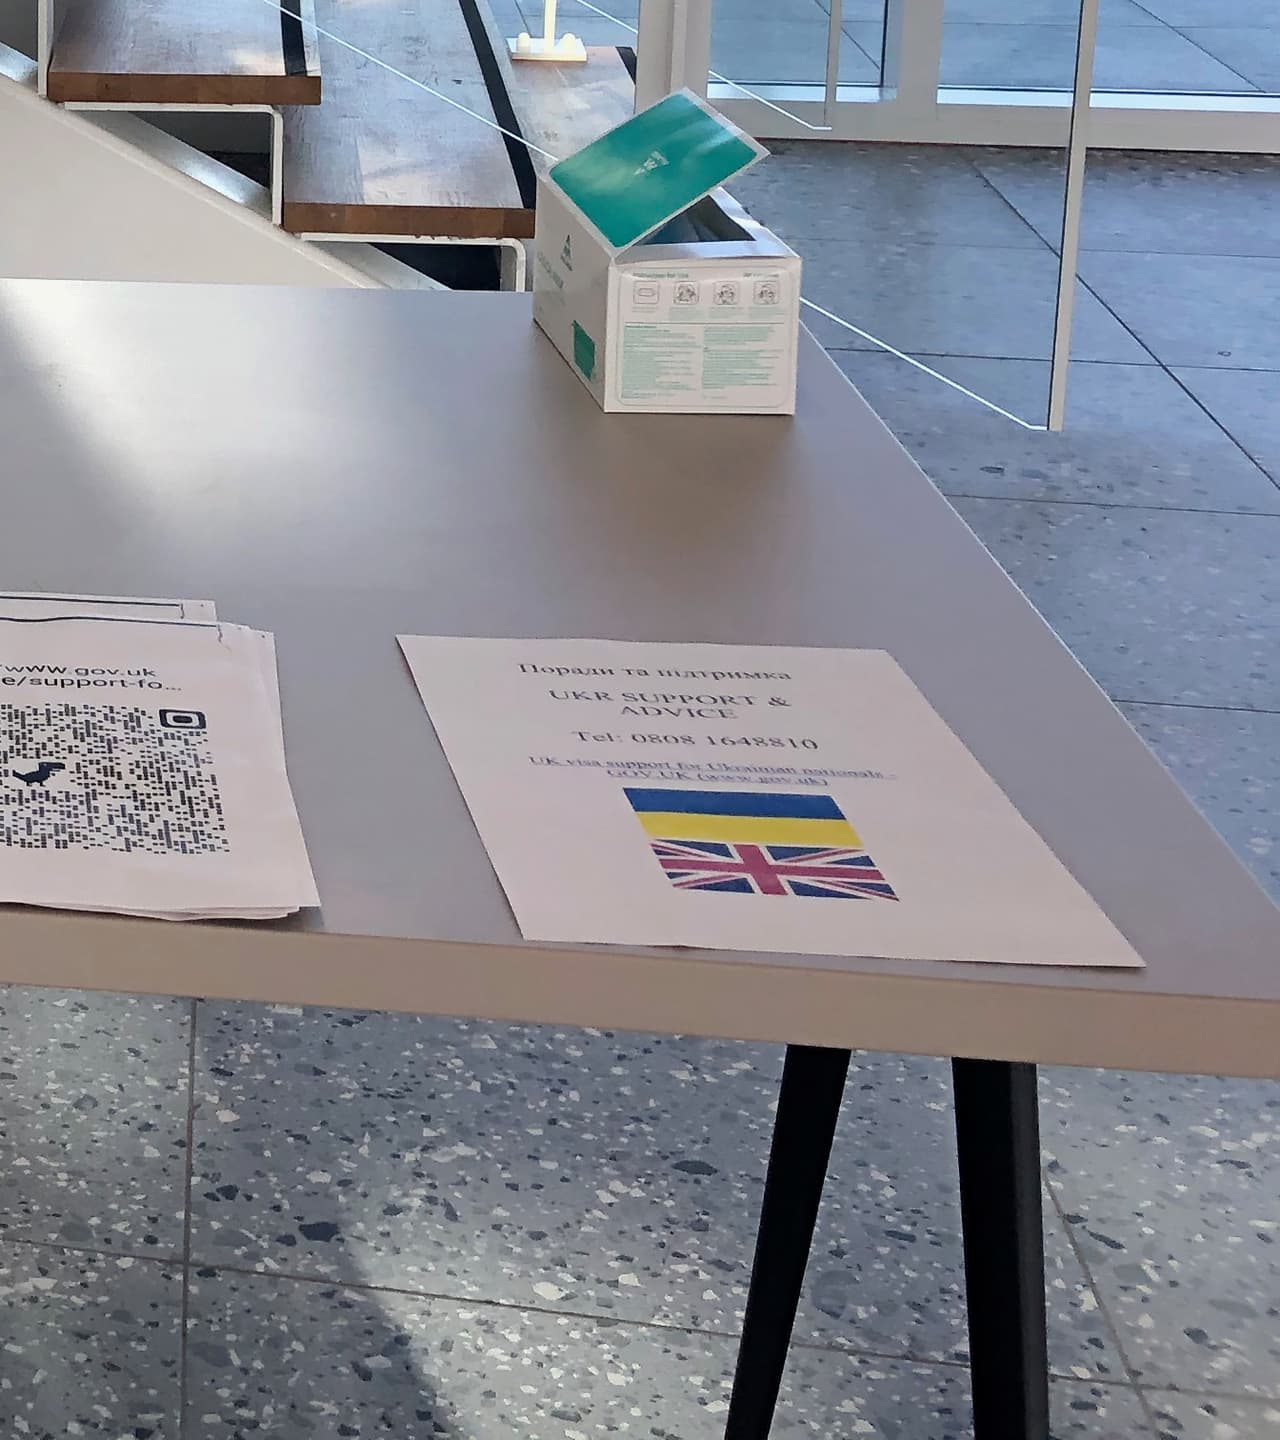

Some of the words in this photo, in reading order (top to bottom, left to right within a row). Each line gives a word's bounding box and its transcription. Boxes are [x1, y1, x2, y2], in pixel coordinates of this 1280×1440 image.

[548, 689, 614, 702] UKR
[621, 692, 758, 707] SUPPORT
[767, 696, 793, 708] &
[620, 705, 739, 719] ADVICE
[631, 733, 696, 746] 0808
[707, 735, 819, 750] 1648810
